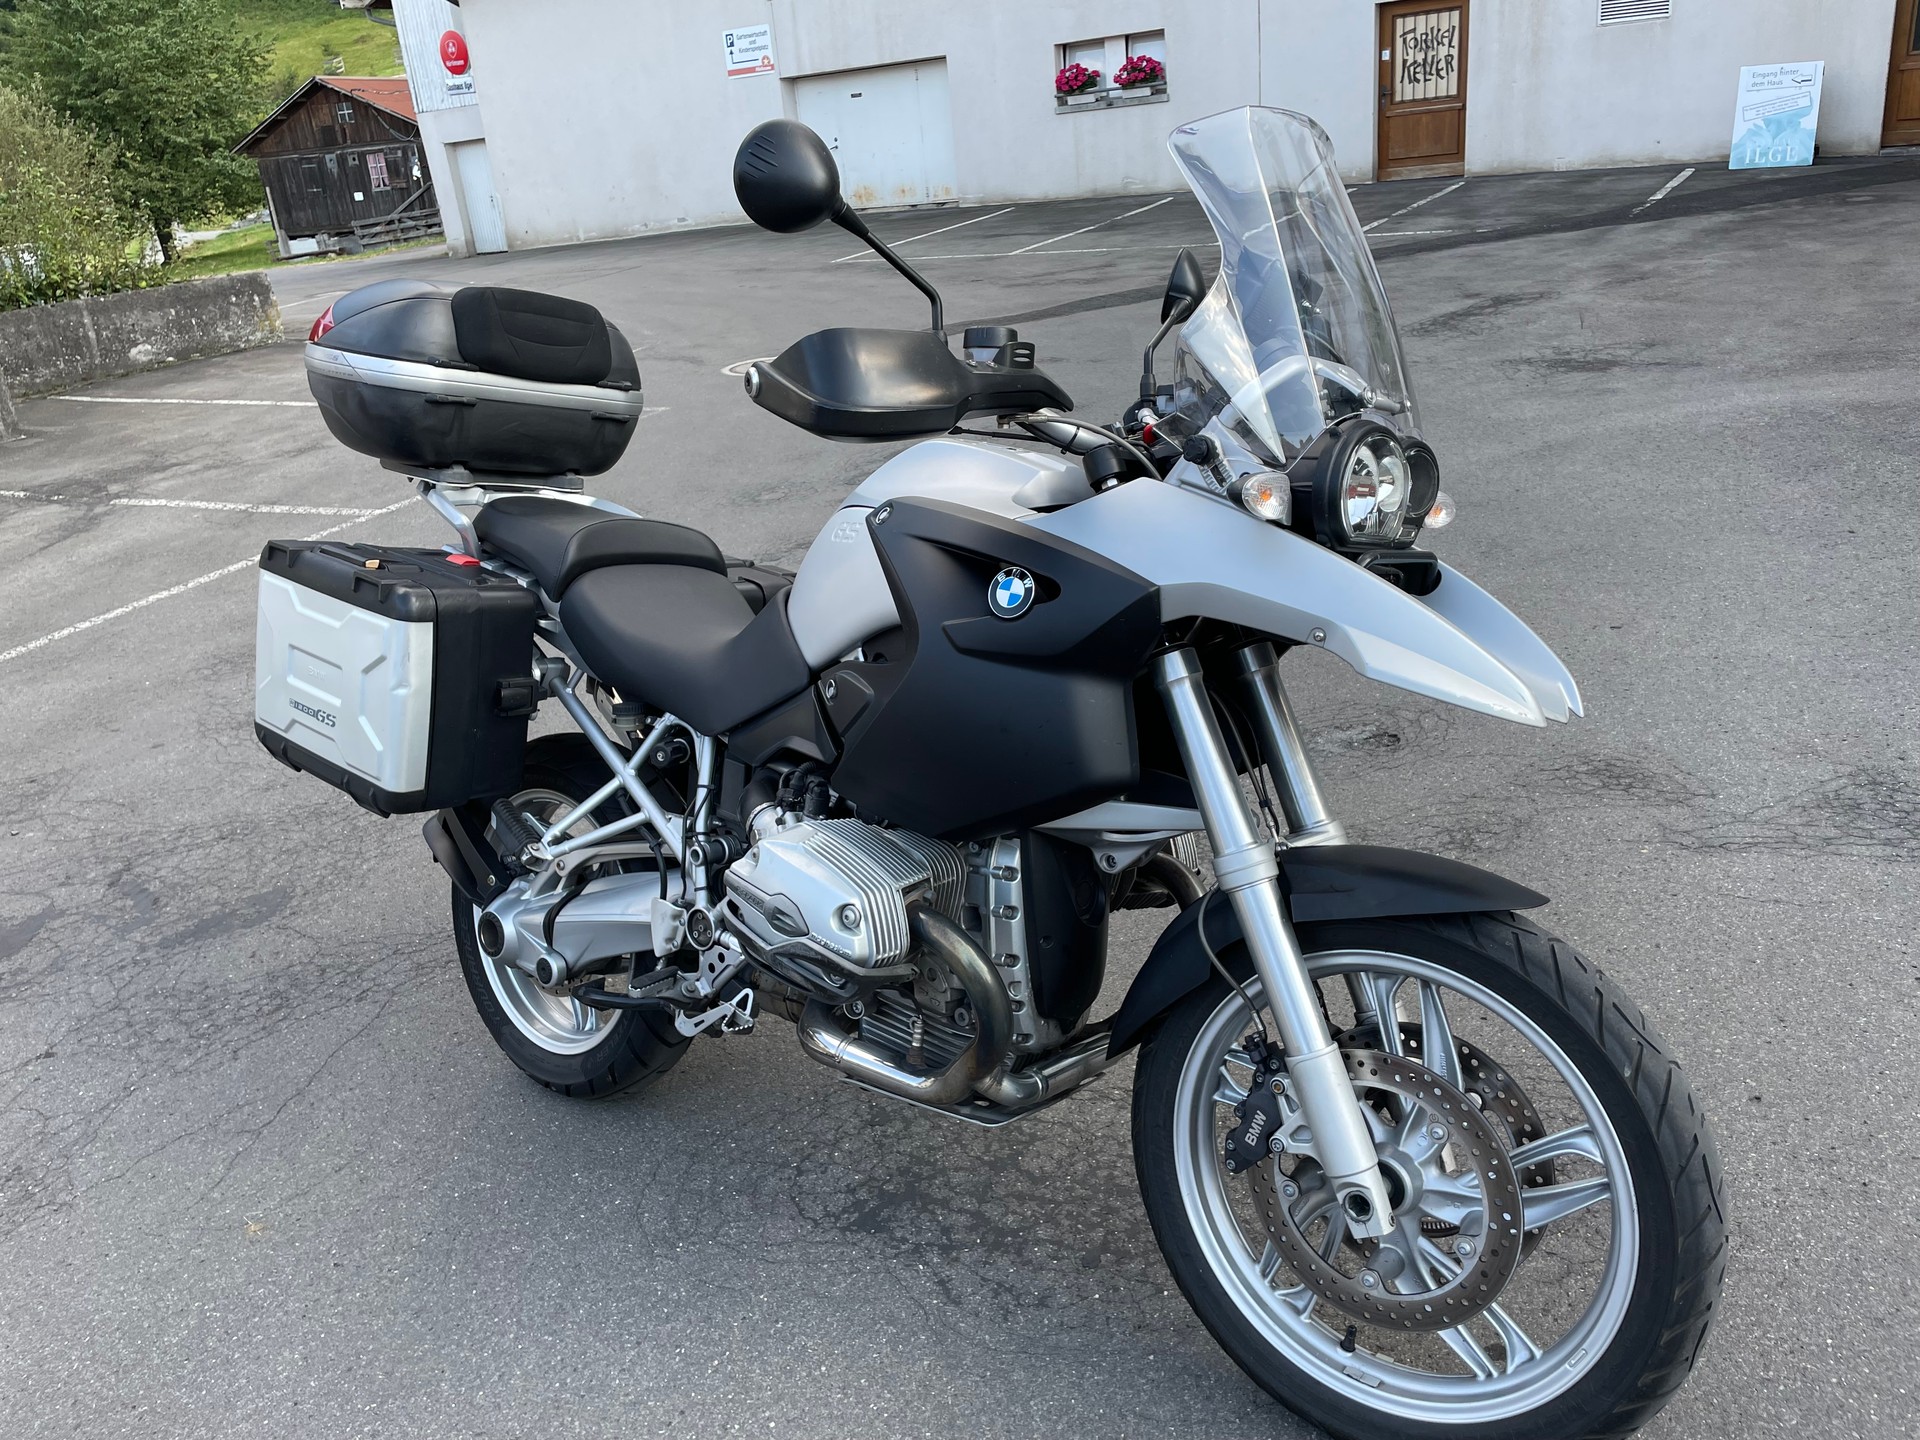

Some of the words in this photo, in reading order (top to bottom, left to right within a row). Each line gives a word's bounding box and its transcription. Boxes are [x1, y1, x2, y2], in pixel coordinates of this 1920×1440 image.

[1399, 25, 1456, 56] TORKEL
[1399, 53, 1455, 85] KELLER
[1752, 70, 1778, 80] Eingang
[1779, 68, 1800, 76] hinter
[1745, 145, 1799, 164] ILGE
[1244, 1109, 1268, 1147] BMW
